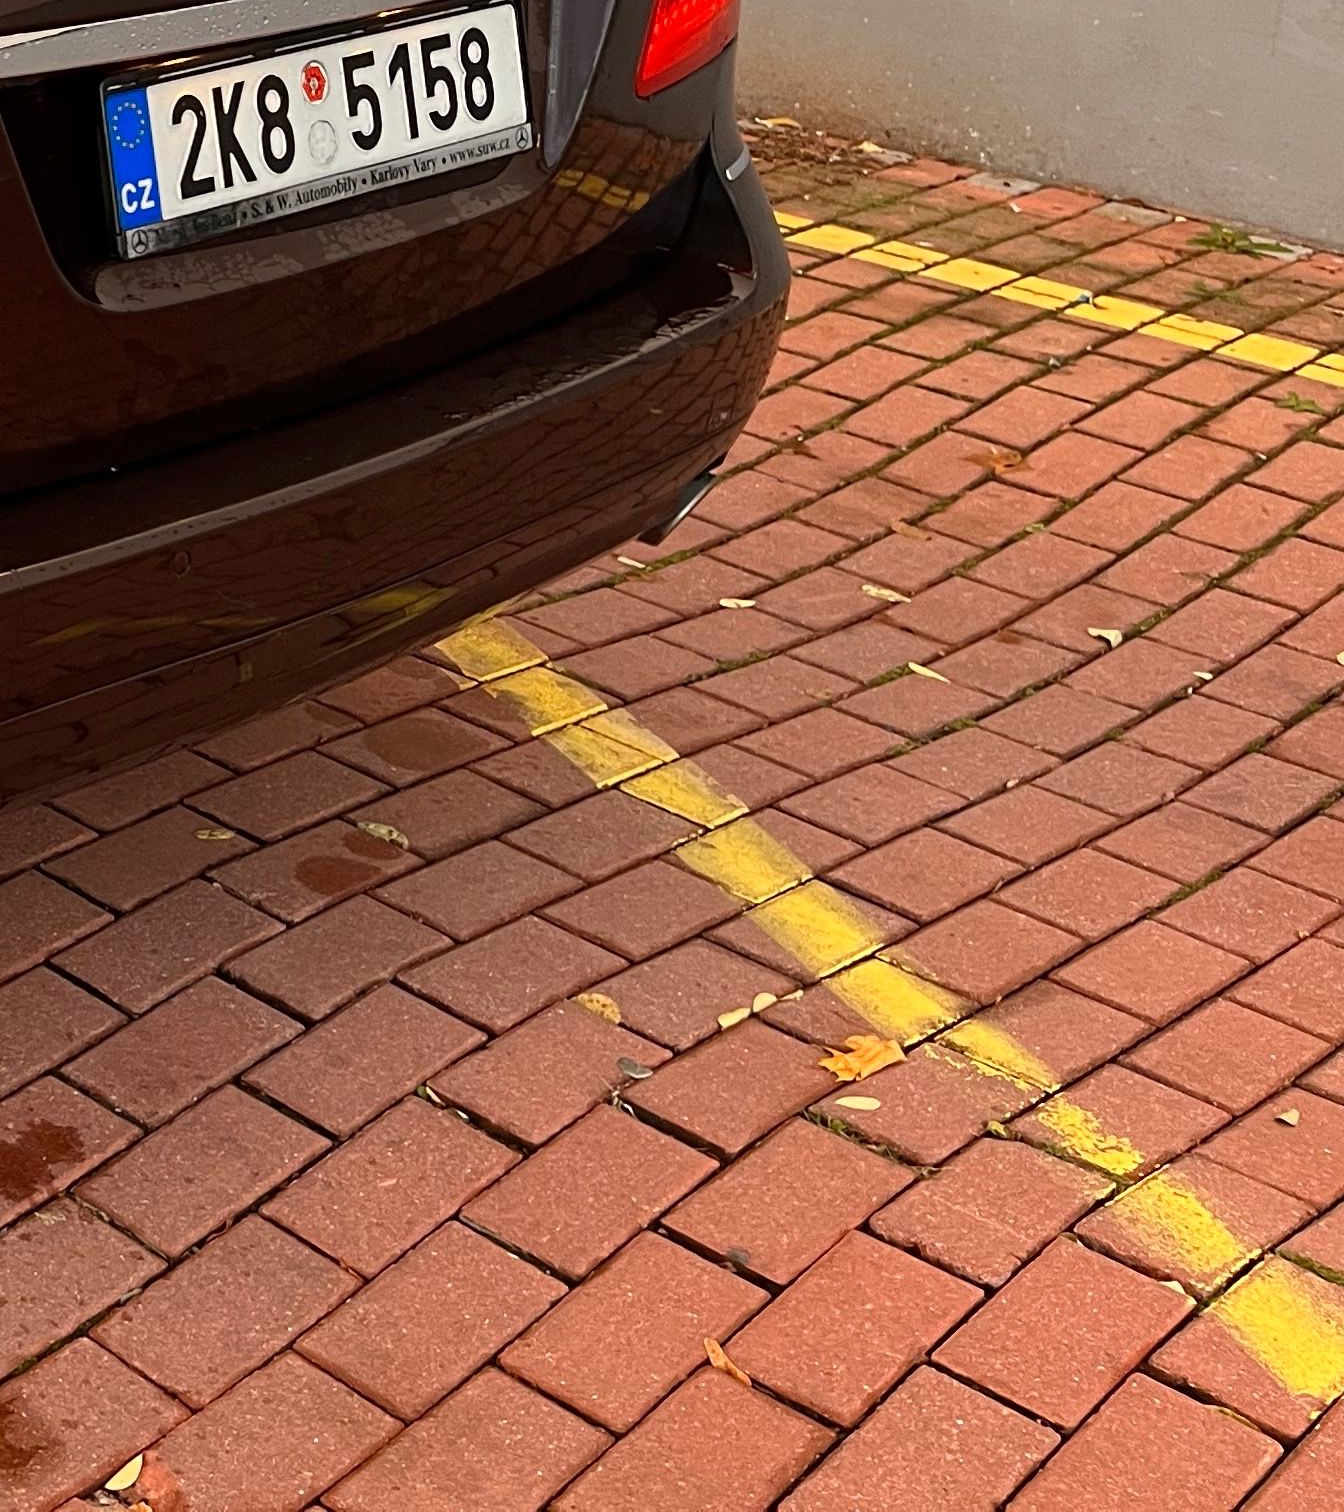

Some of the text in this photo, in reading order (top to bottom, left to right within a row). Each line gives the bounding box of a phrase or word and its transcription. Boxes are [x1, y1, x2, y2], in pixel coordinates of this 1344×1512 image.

[121, 27, 495, 215] CZ 2K8 5158
[294, 176, 358, 206] Automobily
[370, 164, 411, 187] Karlovy
[412, 156, 438, 174] Vary
[449, 137, 511, 164] www.suw.cz
